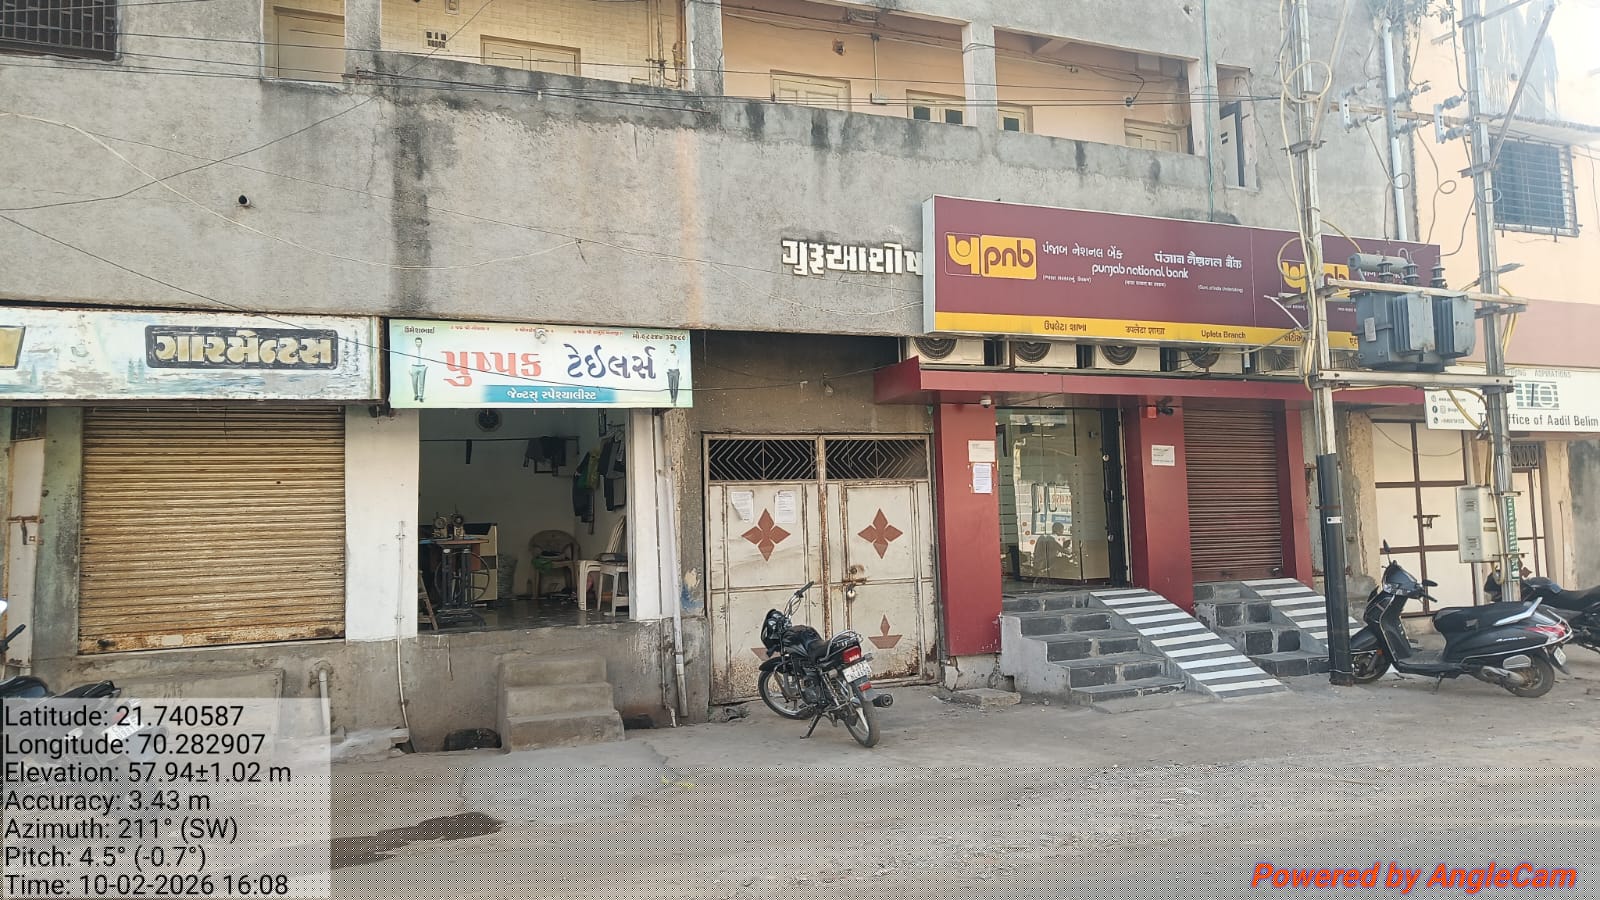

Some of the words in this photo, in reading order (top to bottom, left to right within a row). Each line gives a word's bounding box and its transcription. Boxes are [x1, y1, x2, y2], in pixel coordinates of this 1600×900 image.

[984, 239, 1034, 274] pnb
[1042, 241, 1068, 256] પંજાબ
[1072, 242, 1104, 258] નેશનલ
[1091, 263, 1125, 277] punjab
[1126, 264, 1166, 277] national
[1166, 266, 1189, 279] bank
[1223, 330, 1246, 339] Branch
[441, 350, 542, 387] પુષ્પક
[1533, 414, 1543, 425] of
[1547, 415, 1571, 426] Aadil
